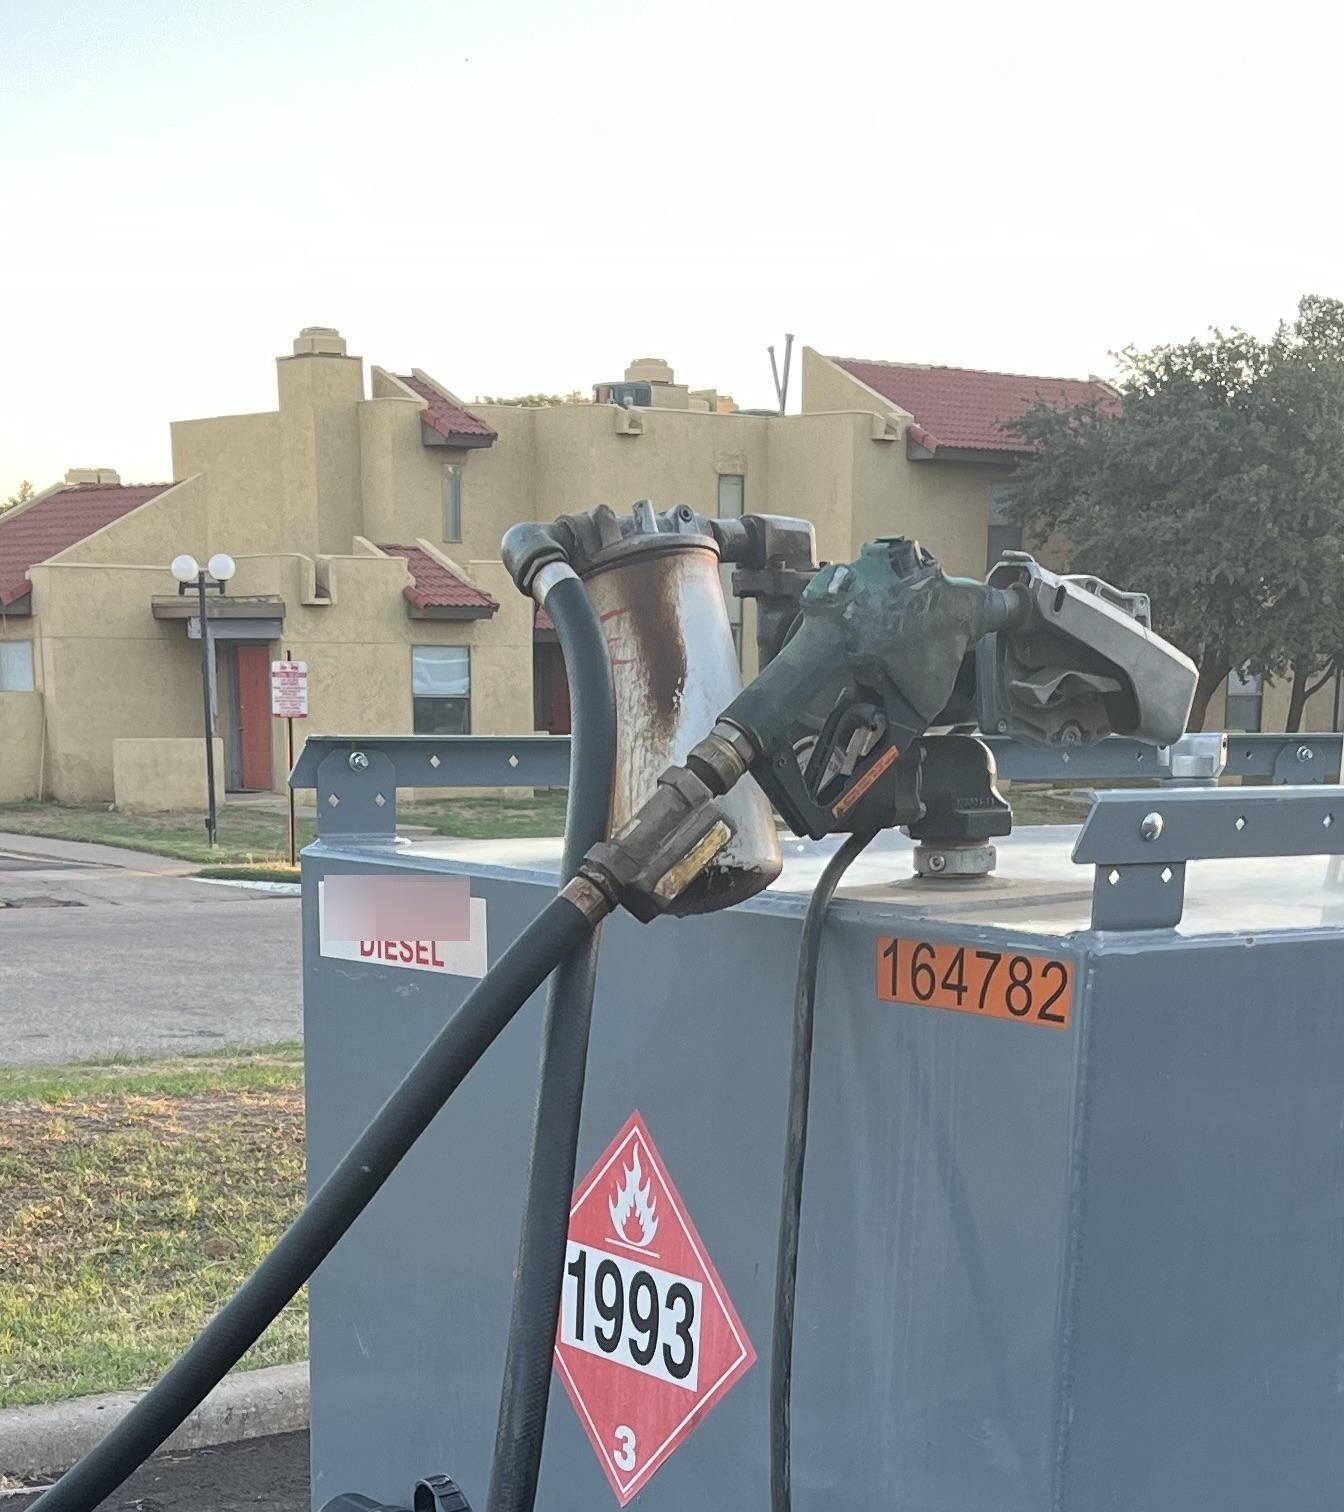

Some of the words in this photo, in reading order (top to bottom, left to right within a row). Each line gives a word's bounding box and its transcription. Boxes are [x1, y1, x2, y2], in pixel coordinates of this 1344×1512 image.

[360, 940, 444, 967] DIESEL
[883, 938, 1068, 1023] 164782
[568, 1249, 695, 1380] 1993
[613, 1425, 636, 1472] 3
